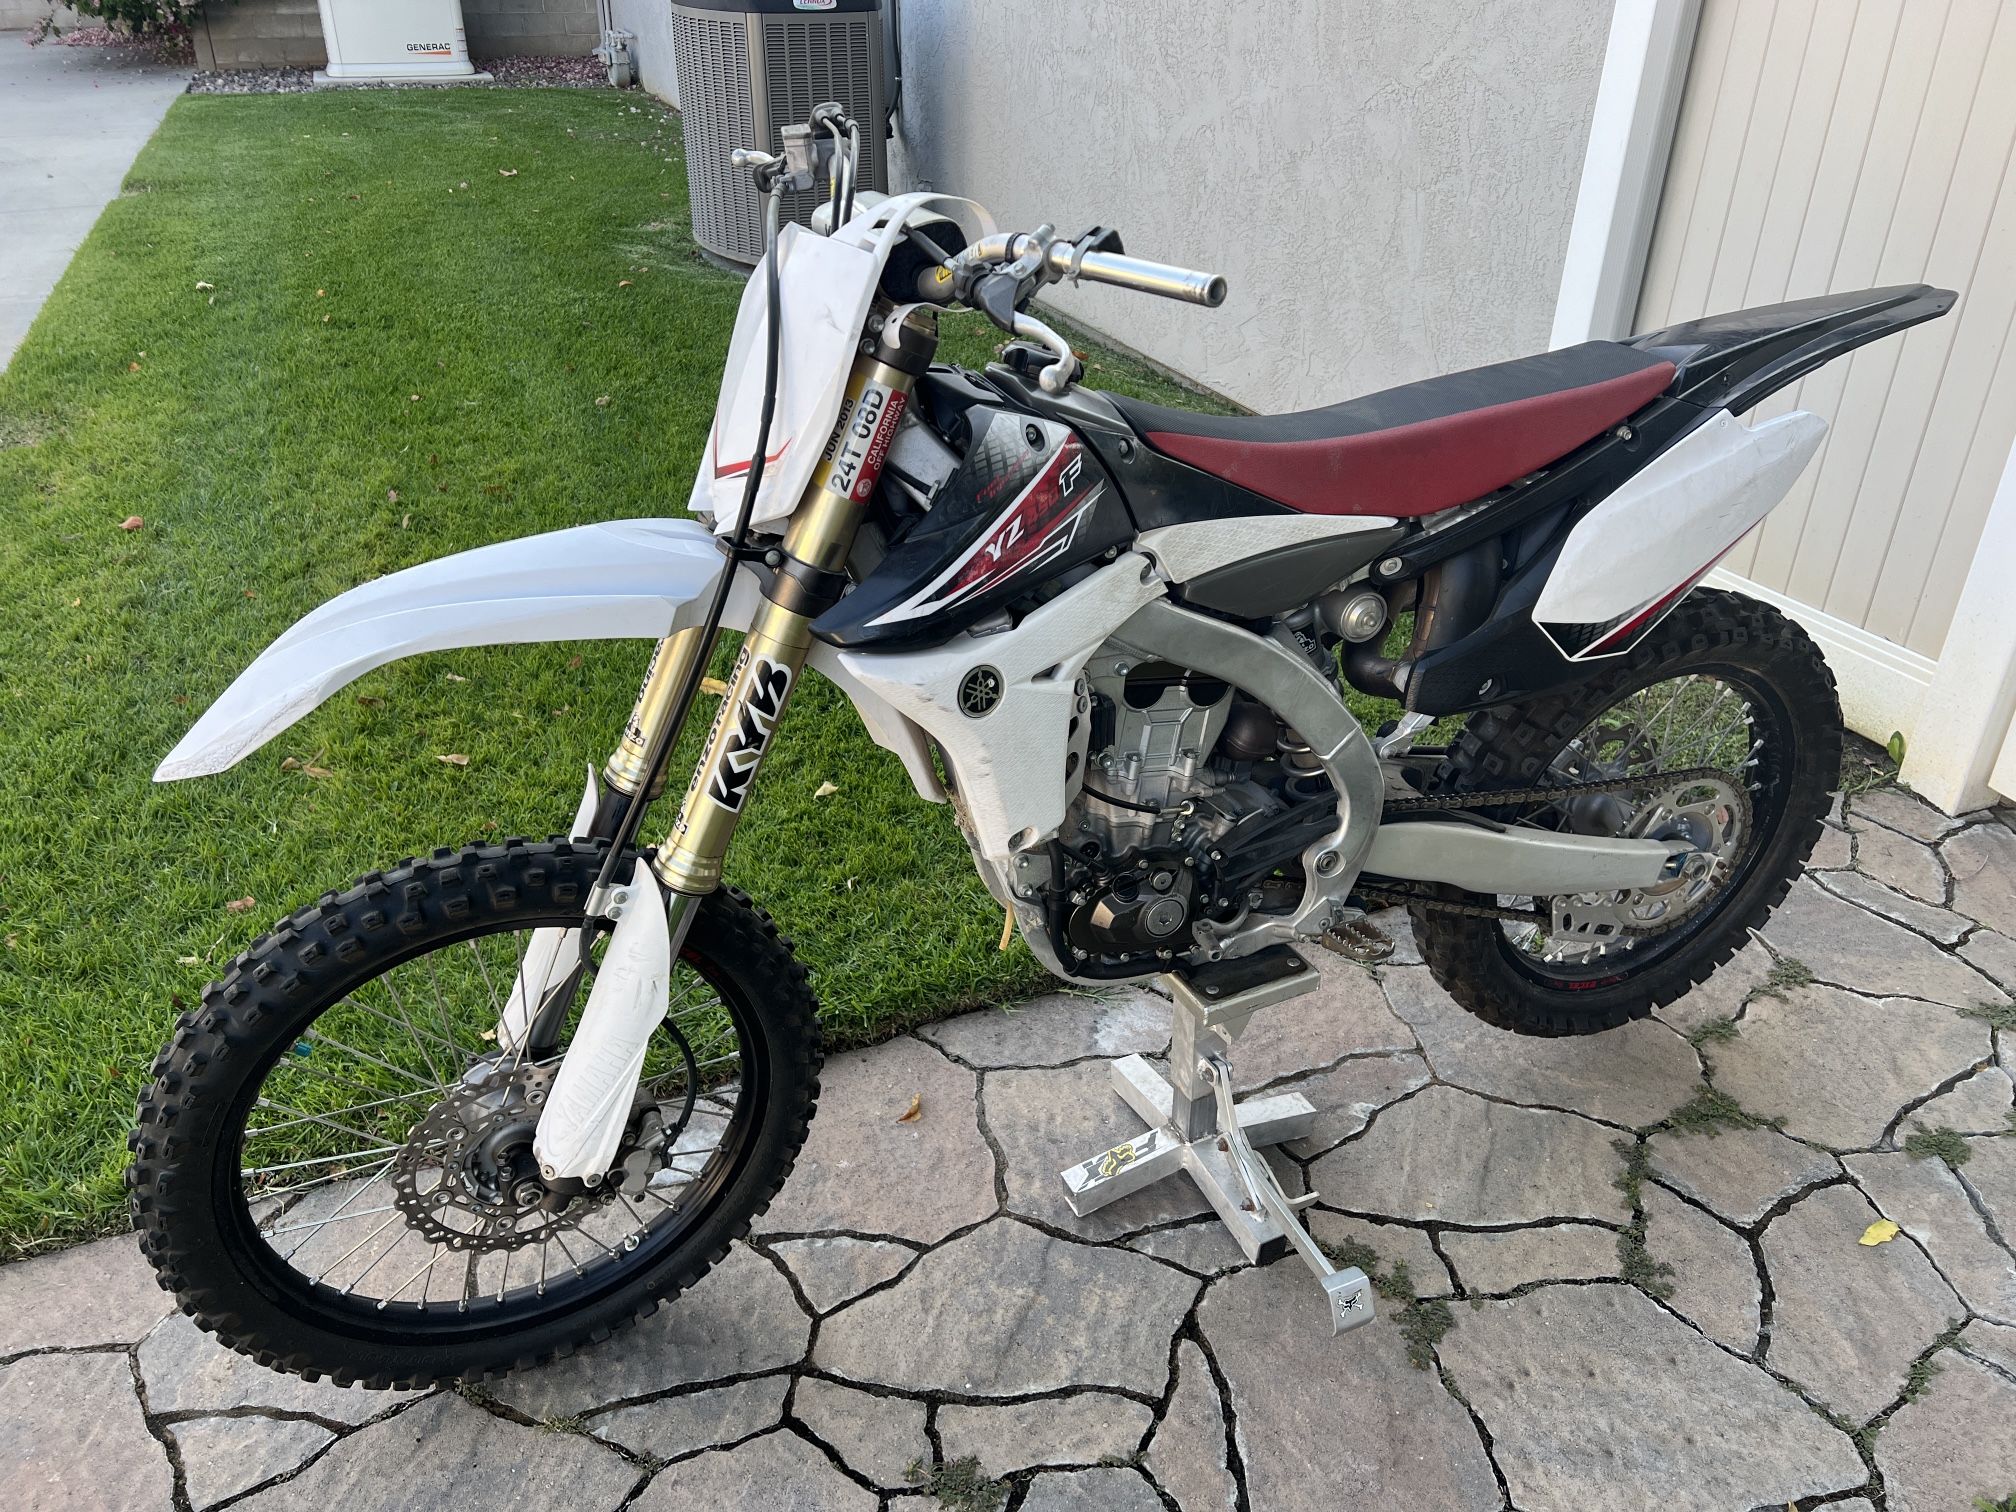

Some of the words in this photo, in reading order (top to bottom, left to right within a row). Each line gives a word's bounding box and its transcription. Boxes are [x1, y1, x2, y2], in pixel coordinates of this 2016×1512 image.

[406, 43, 451, 51] GENERAC
[824, 434, 840, 461] JUN
[839, 399, 854, 431] 2013
[867, 400, 898, 464] CALIFORNIA
[873, 450, 885, 470] OFF
[884, 397, 905, 448] HIGHWAY
[831, 441, 861, 492] 24T
[985, 514, 1024, 562] YZ
[1058, 452, 1082, 497] F
[705, 654, 793, 814] KYB
